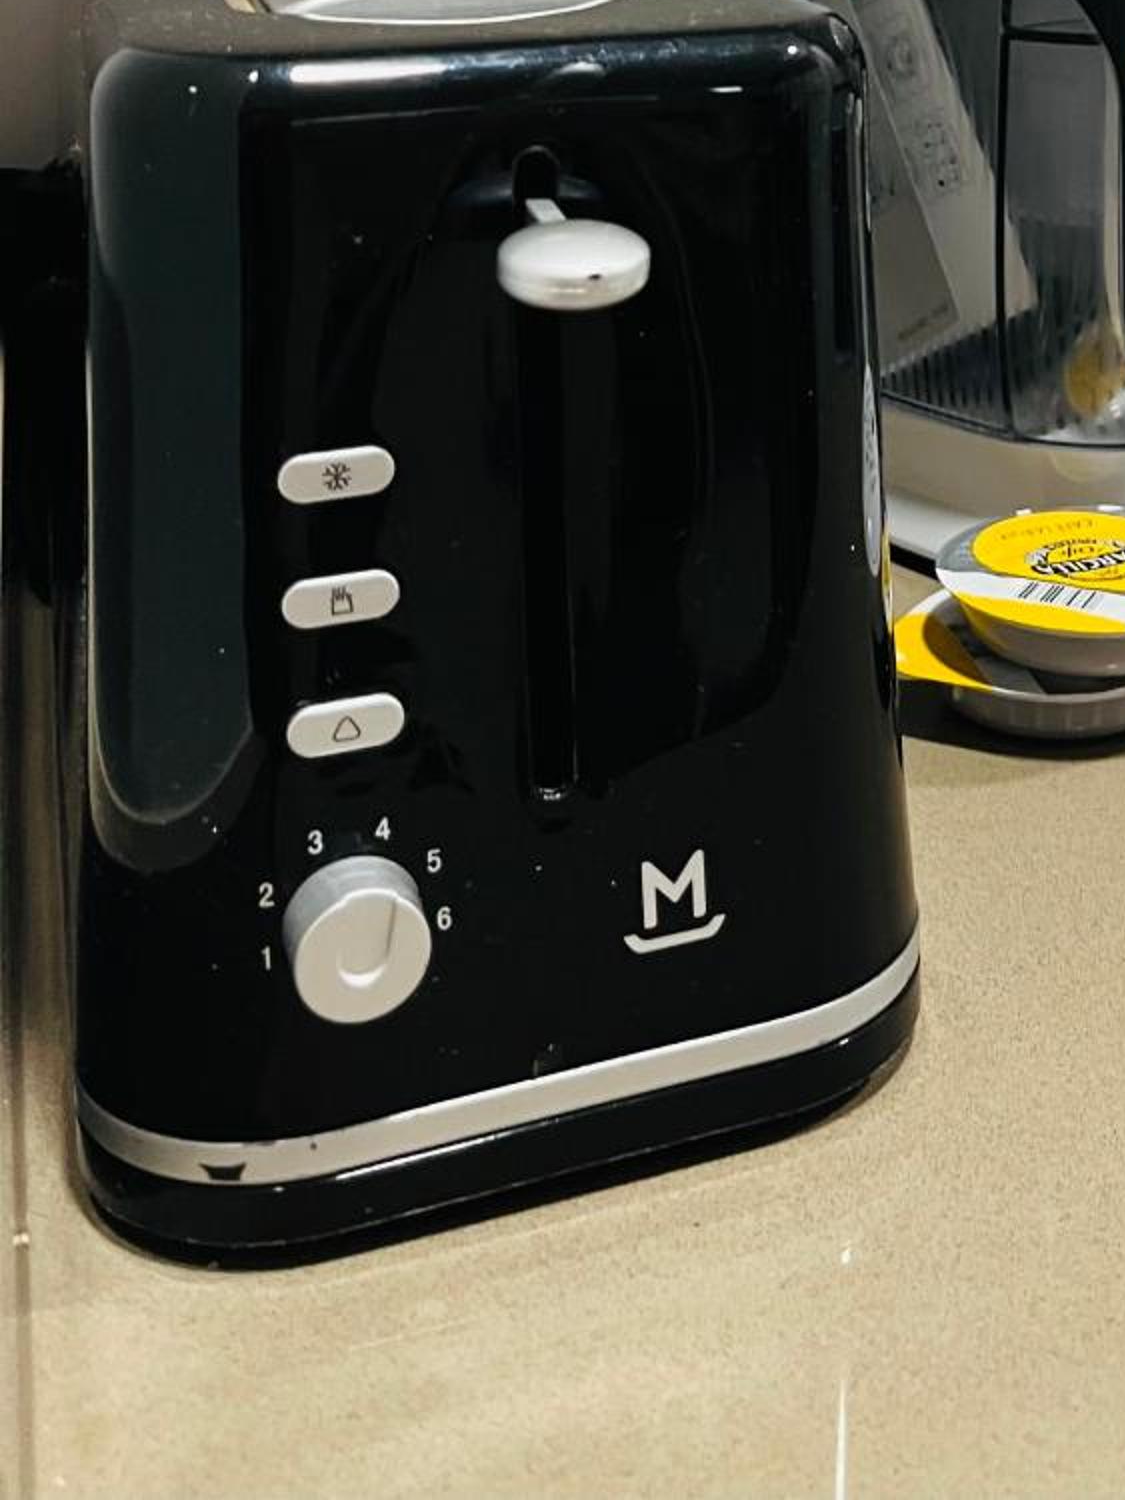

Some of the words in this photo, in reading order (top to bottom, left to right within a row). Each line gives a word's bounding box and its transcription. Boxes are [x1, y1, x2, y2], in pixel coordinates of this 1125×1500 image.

[375, 817, 391, 841] 4
[307, 830, 324, 855] 3
[426, 849, 442, 873] 5
[258, 883, 275, 908] 2
[436, 906, 452, 931] 6
[261, 946, 272, 970] 1
